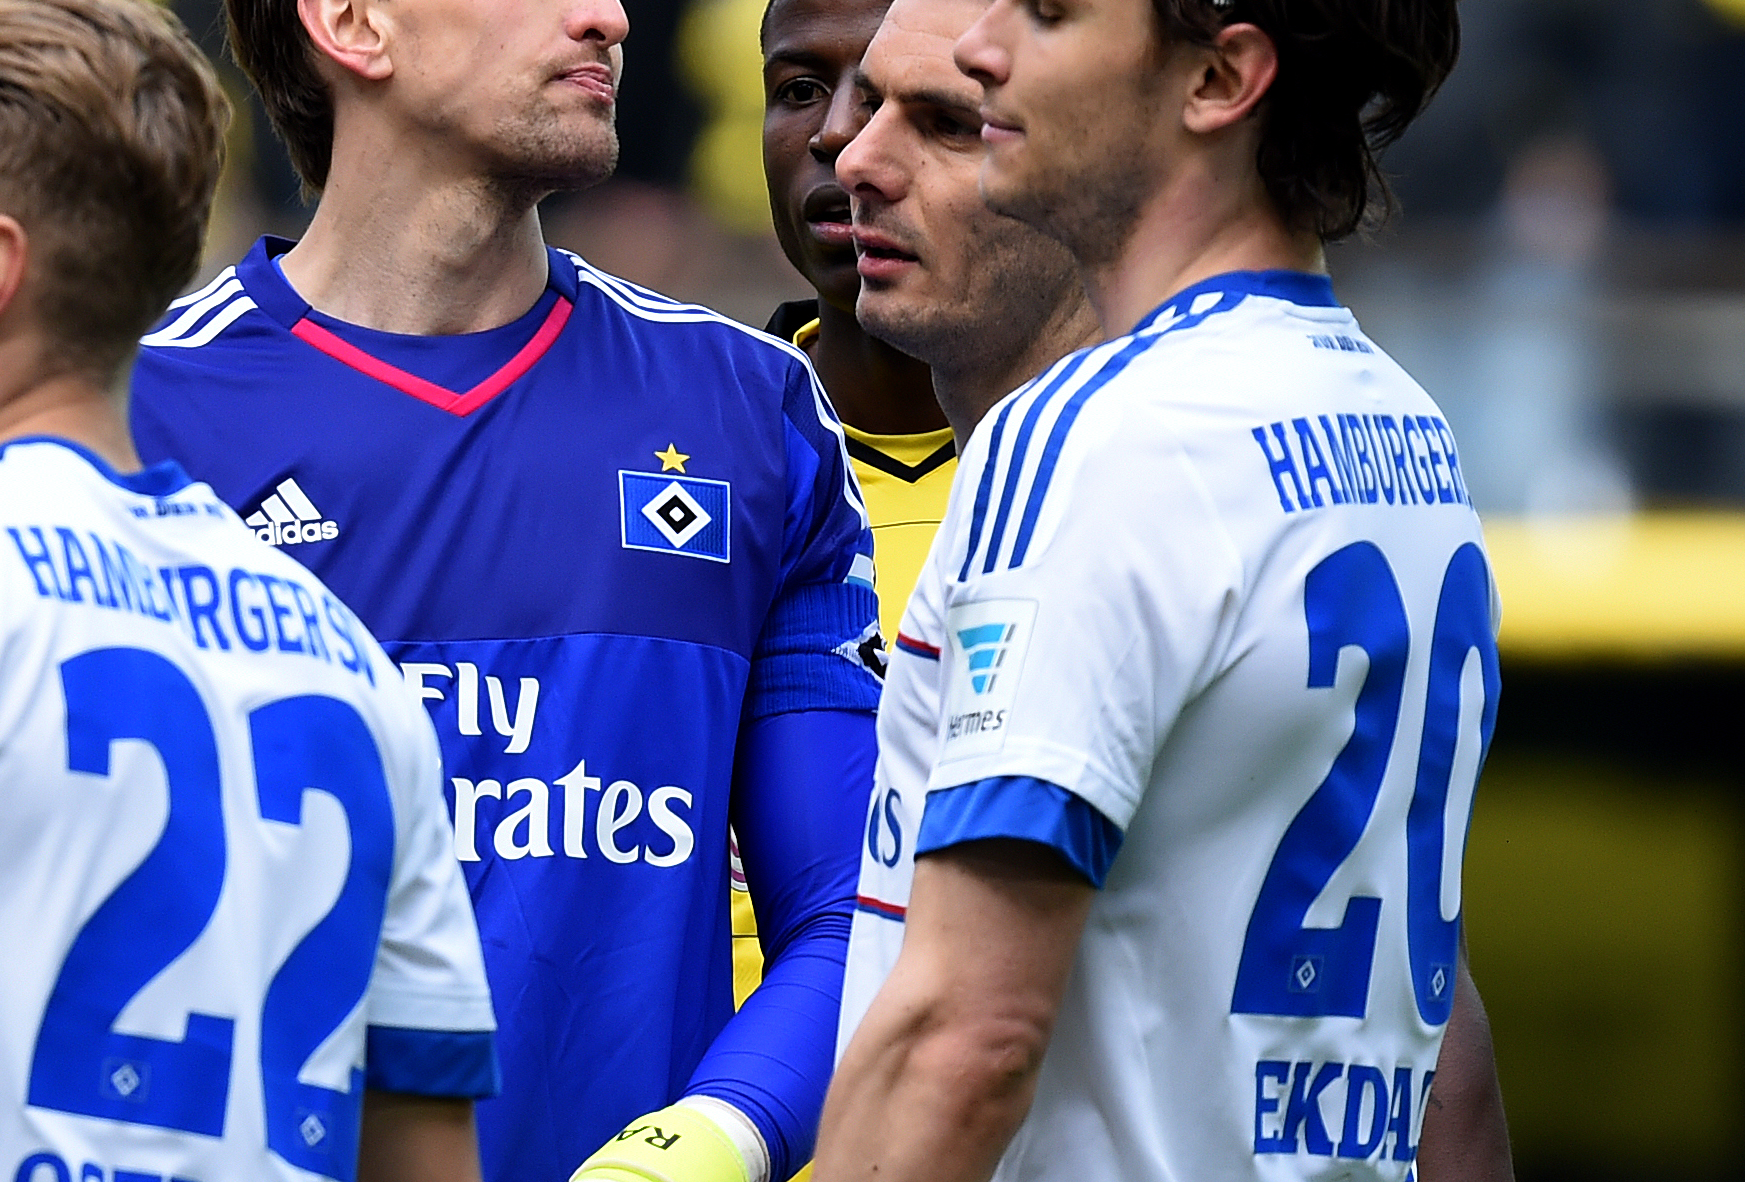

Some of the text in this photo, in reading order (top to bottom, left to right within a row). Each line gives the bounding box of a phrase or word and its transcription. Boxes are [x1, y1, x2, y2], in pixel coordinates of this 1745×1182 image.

[1251, 413, 1469, 513] HAMBURGER
[252, 519, 339, 546] didas
[451, 759, 694, 867] rates
[1230, 540, 1501, 1025] 20
[24, 646, 397, 1182] 22
[1253, 1060, 1437, 1163] EKDA
